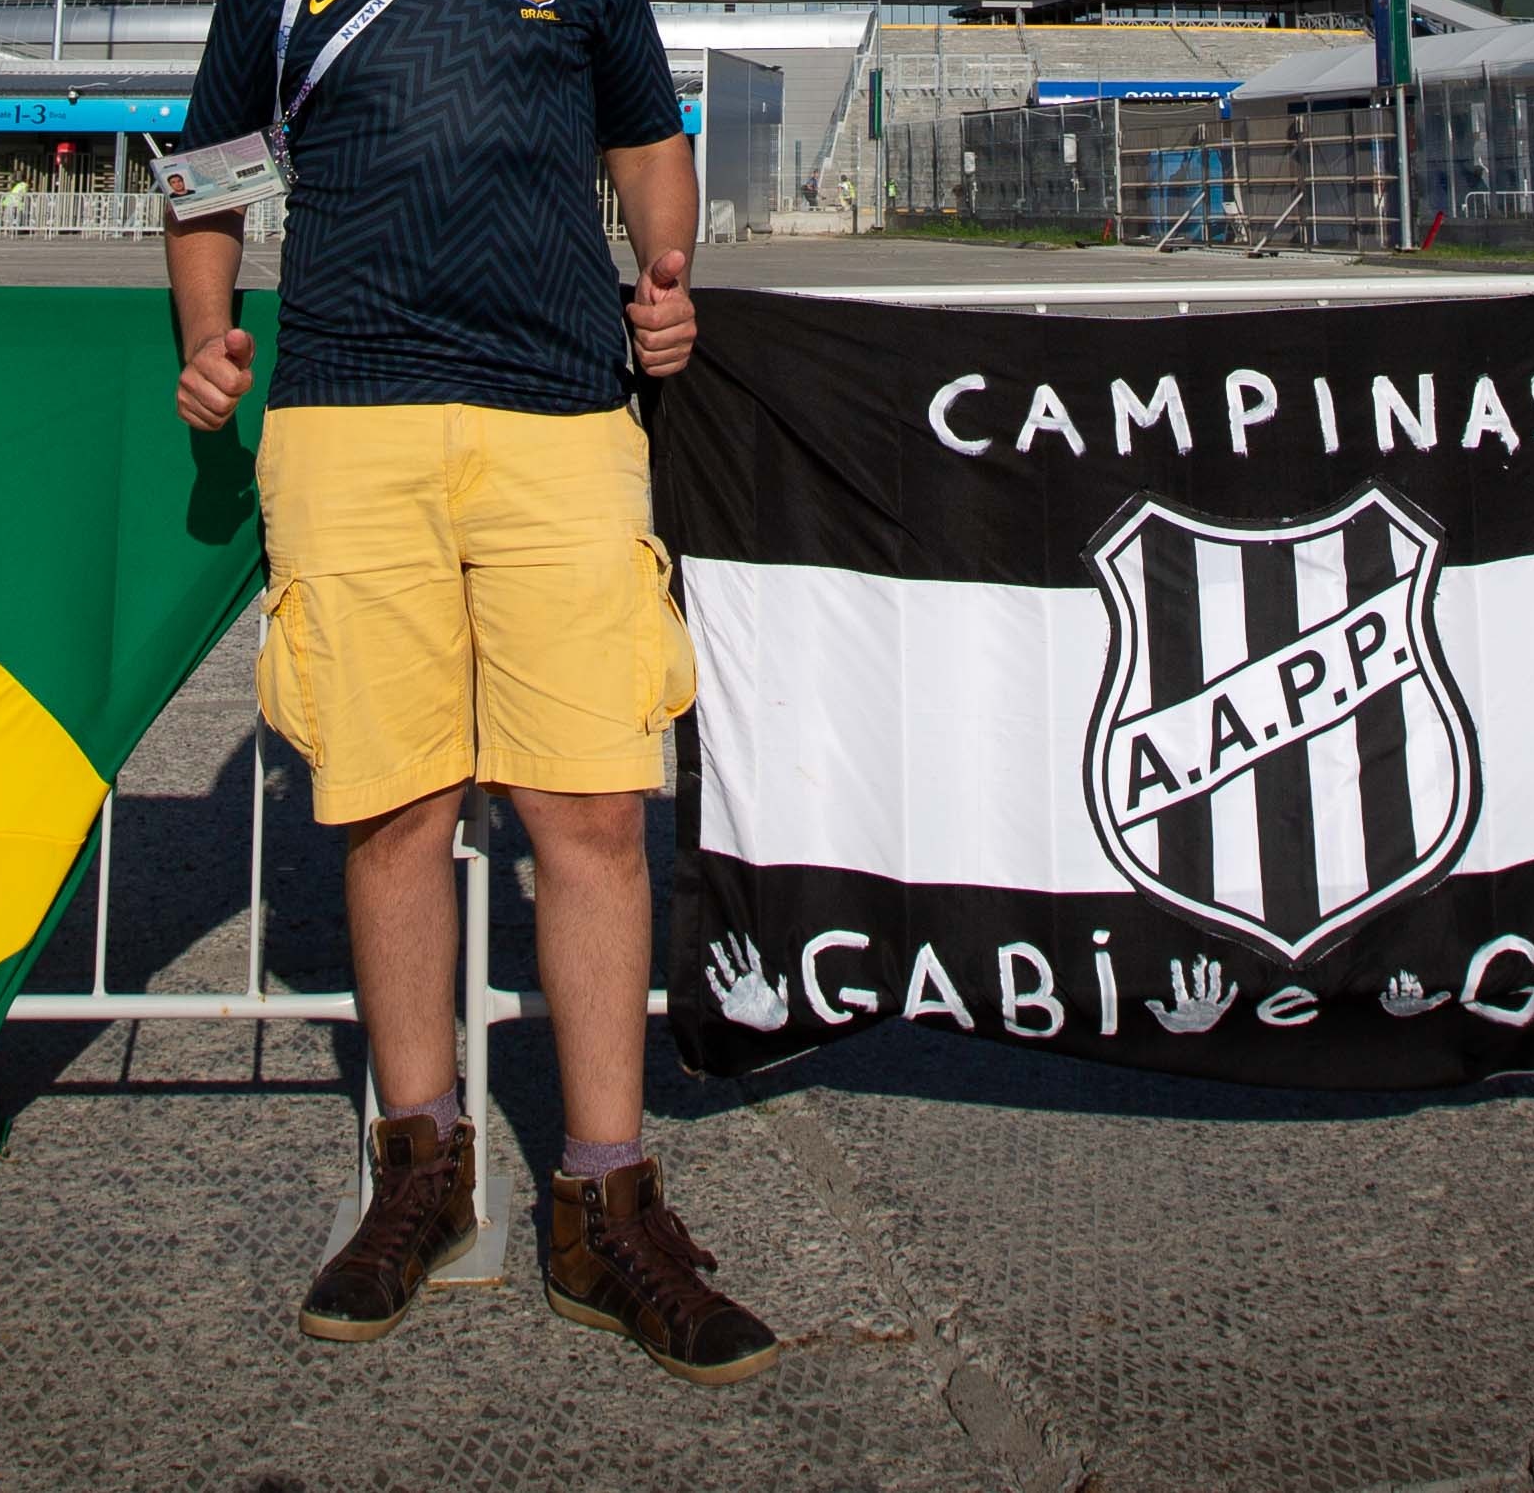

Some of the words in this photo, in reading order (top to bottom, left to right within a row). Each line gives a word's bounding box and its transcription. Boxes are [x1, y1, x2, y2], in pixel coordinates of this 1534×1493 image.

[520, 8, 562, 21] BRASIL
[14, 104, 46, 124] 1-3
[1124, 609, 1410, 812] A.A.P.P.
[1256, 985, 1319, 1026] e
